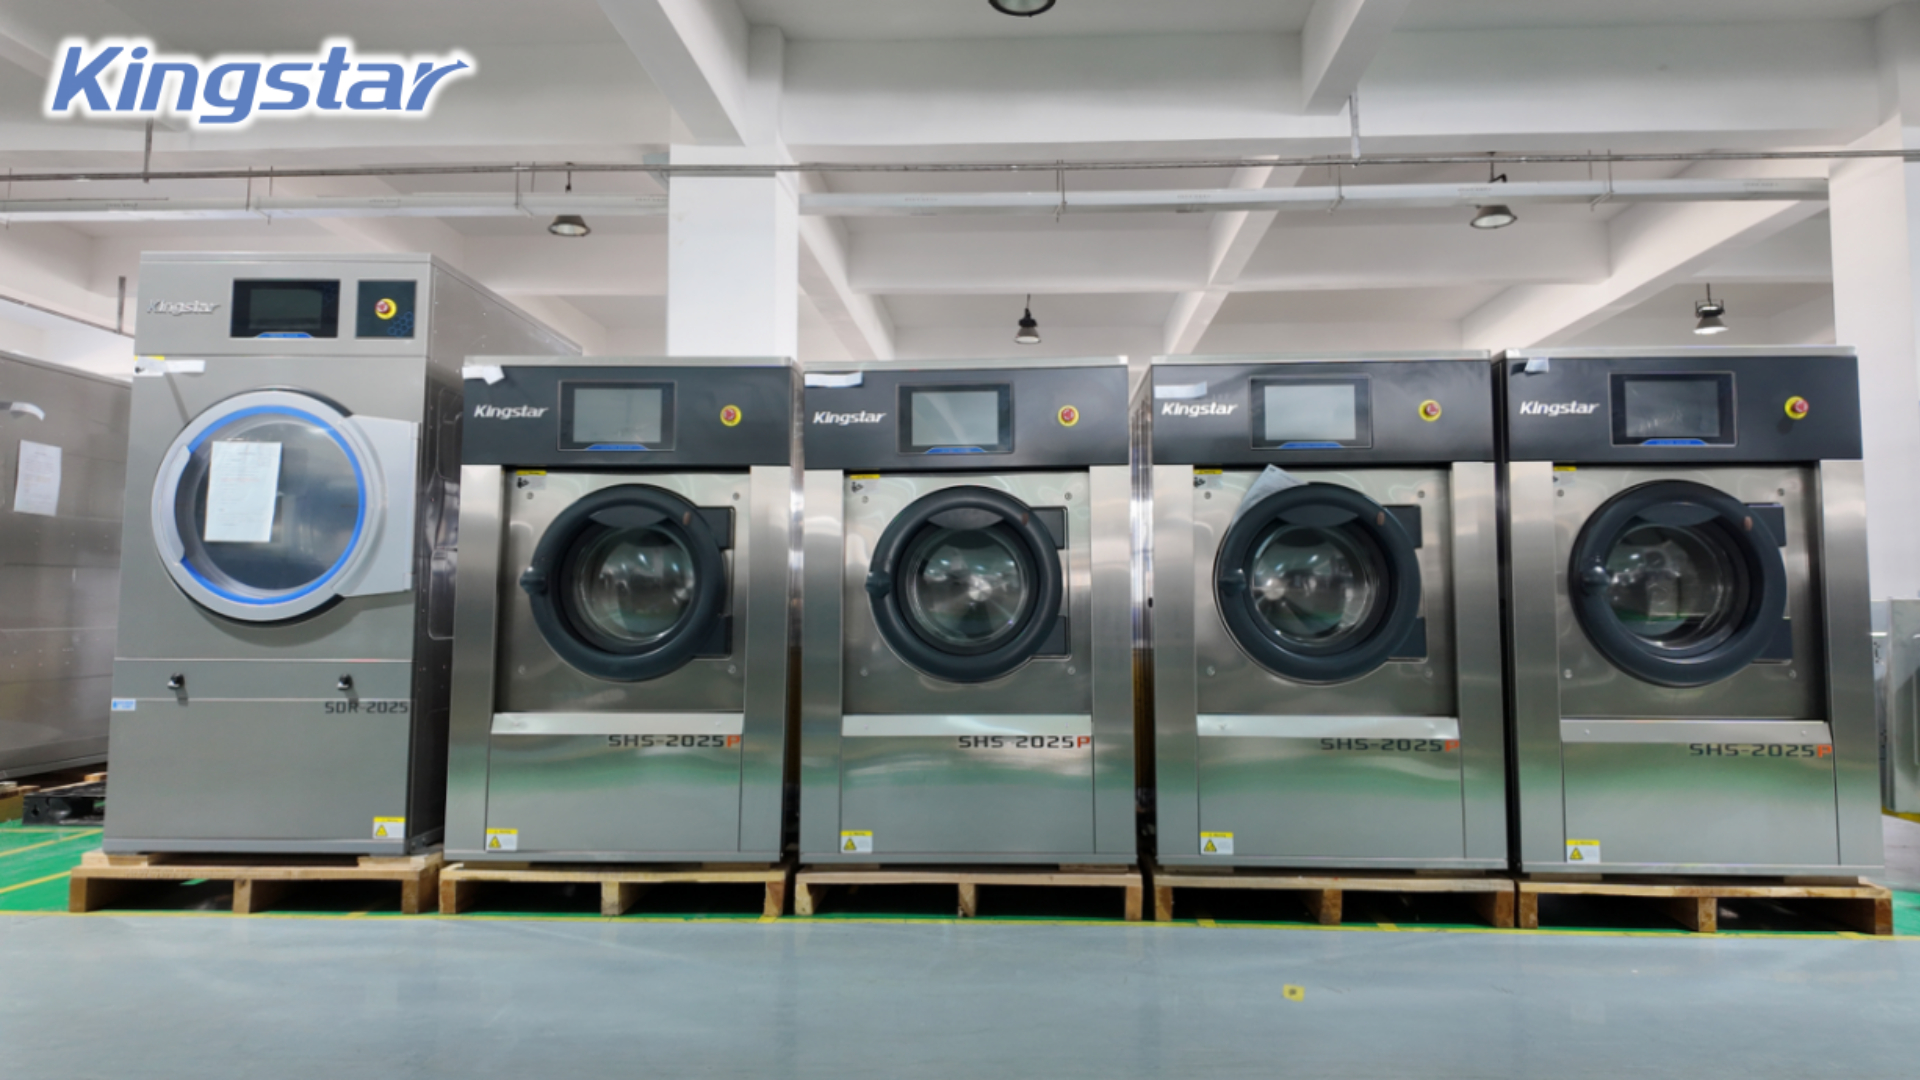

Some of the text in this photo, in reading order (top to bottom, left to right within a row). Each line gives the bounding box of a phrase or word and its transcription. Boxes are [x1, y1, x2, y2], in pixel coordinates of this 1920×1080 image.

[147, 300, 220, 316] Kingstar
[473, 404, 548, 420] Kingstar
[1161, 401, 1238, 418] Kingstar
[1519, 400, 1600, 417] Kingstar
[812, 410, 886, 427] Kingstar
[325, 701, 409, 715] SDR-2025
[608, 735, 741, 748] SHS-2025P
[958, 735, 1091, 749] SHS-2025P
[1320, 737, 1460, 753] SHS-2025P
[1689, 743, 1833, 759] SHS-2025P
